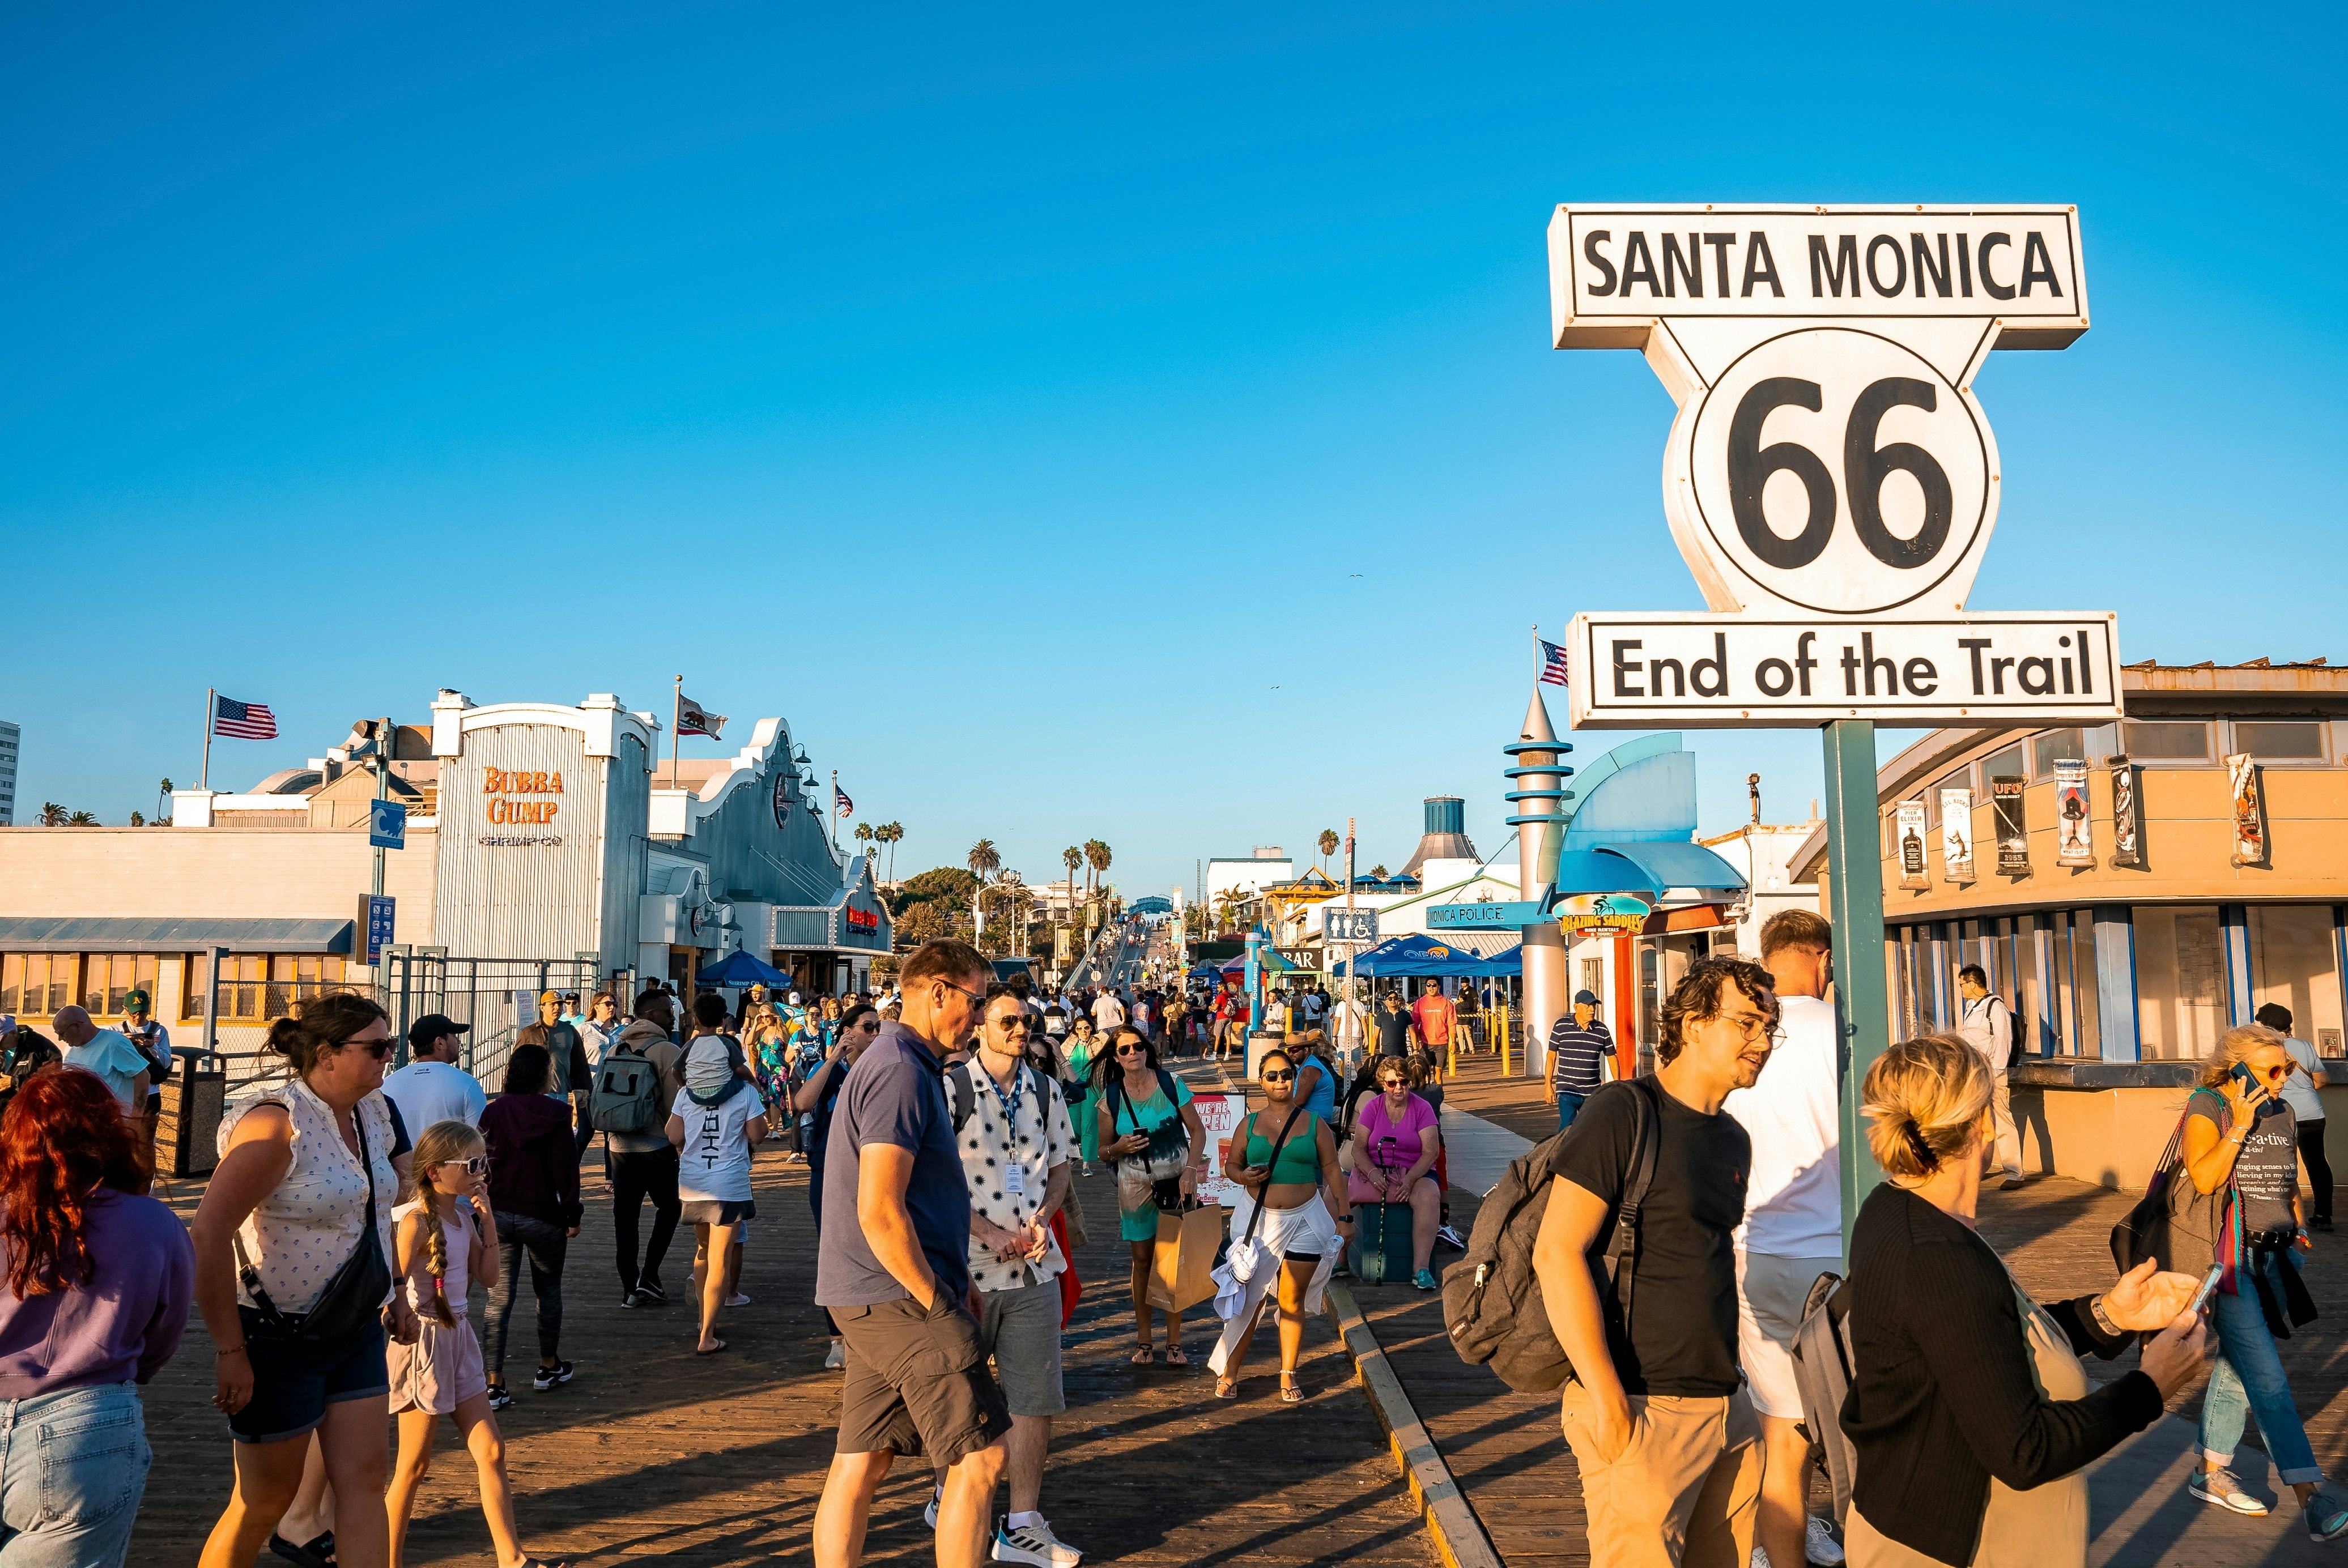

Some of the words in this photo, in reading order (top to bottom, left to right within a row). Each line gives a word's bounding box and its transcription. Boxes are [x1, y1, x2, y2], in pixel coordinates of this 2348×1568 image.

[1584, 230, 1785, 298] SANTA
[1809, 231, 2064, 300] MONICA
[1727, 376, 1953, 569] 66
[1612, 632, 1728, 697] End
[1755, 631, 1818, 697] of
[1840, 632, 1938, 697] the
[1958, 629, 2092, 696] Trail
[483, 766, 564, 794] BUBBA
[1995, 783, 2022, 794] UFO
[487, 797, 558, 824] GUMP
[1430, 909, 1456, 923] MONICA
[1460, 907, 1504, 921] POLICE
[1562, 915, 1601, 934] BLAZING
[1603, 914, 1642, 932] SADDLES
[1282, 952, 1316, 968] BAR
[1194, 1102, 1228, 1114] WE'RE
[1199, 1113, 1231, 1131] PEN
[2236, 1171, 2263, 1179] lieving
